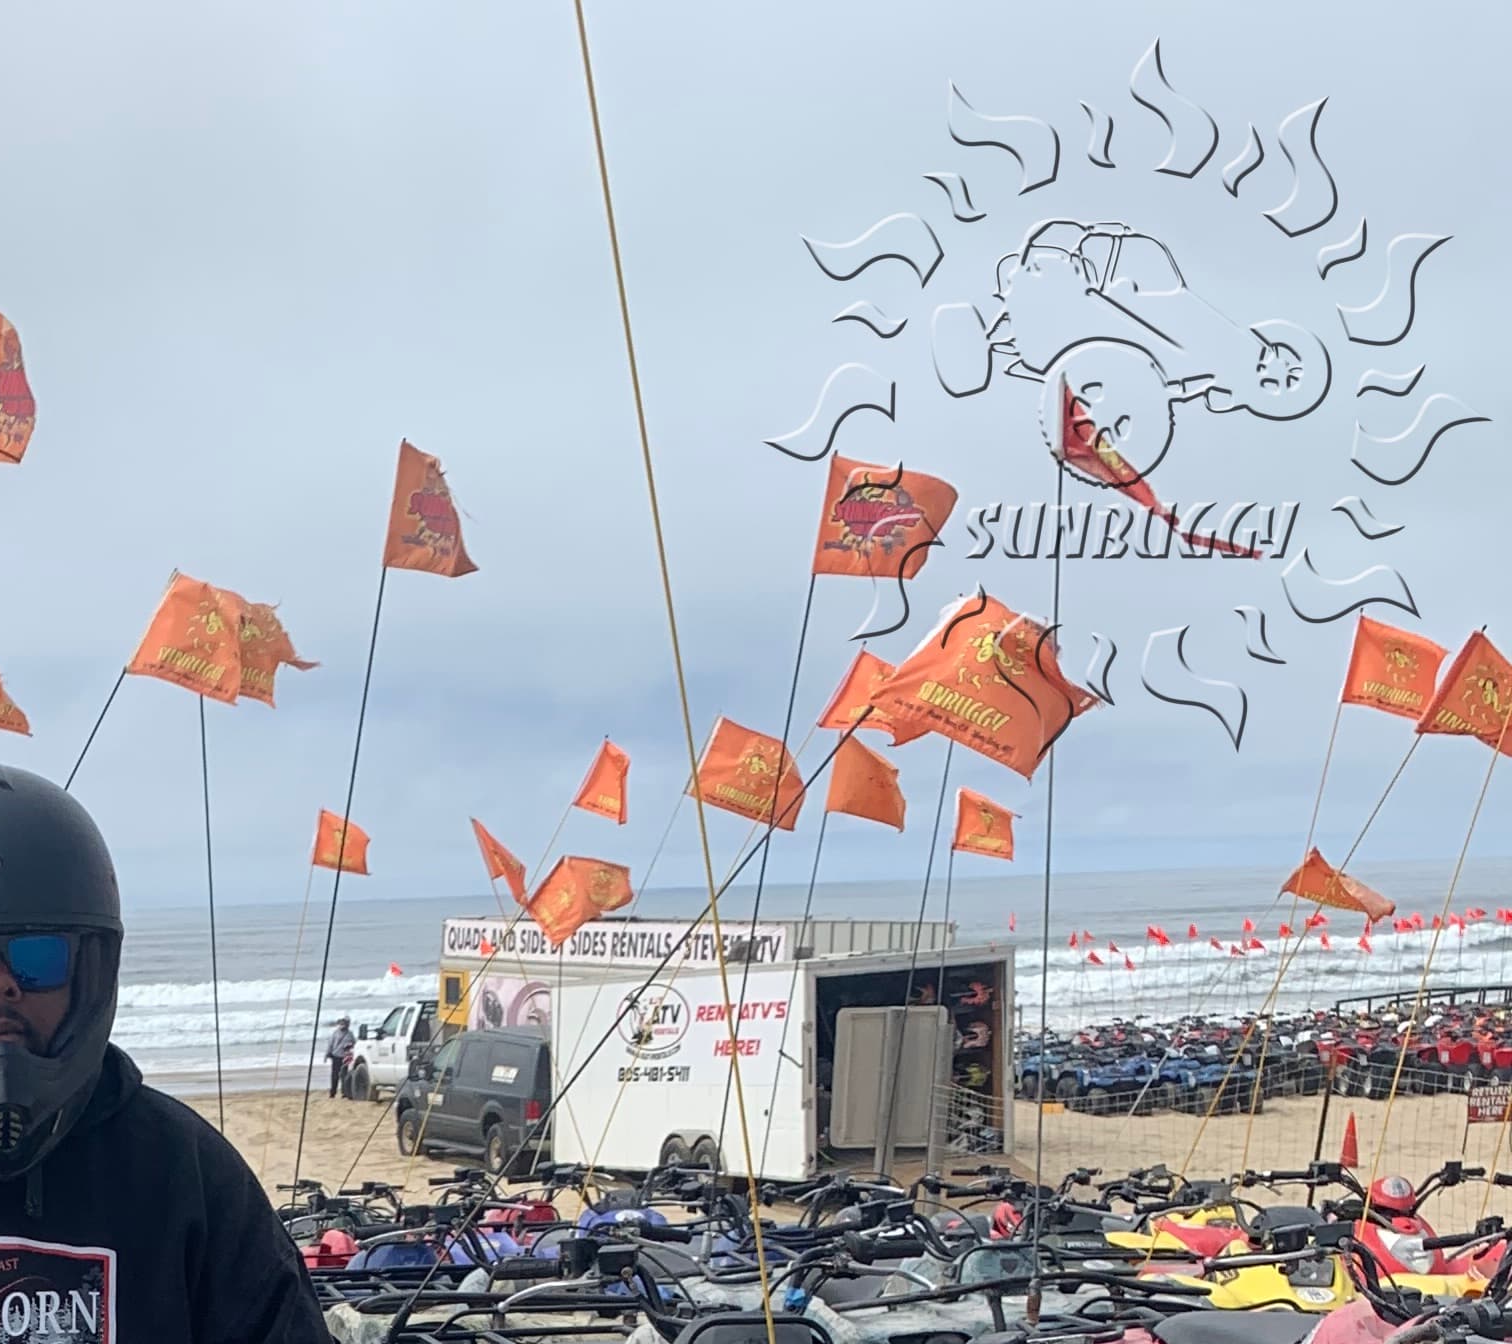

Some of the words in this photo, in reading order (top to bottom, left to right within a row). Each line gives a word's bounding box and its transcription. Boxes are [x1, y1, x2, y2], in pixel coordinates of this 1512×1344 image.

[520, 929, 546, 954] SIDE
[570, 931, 607, 956] SIDES
[613, 932, 671, 958] RENTALS
[651, 1003, 681, 1025] ATV
[695, 1004, 735, 1022] RENT
[713, 1039, 761, 1057] HERE!
